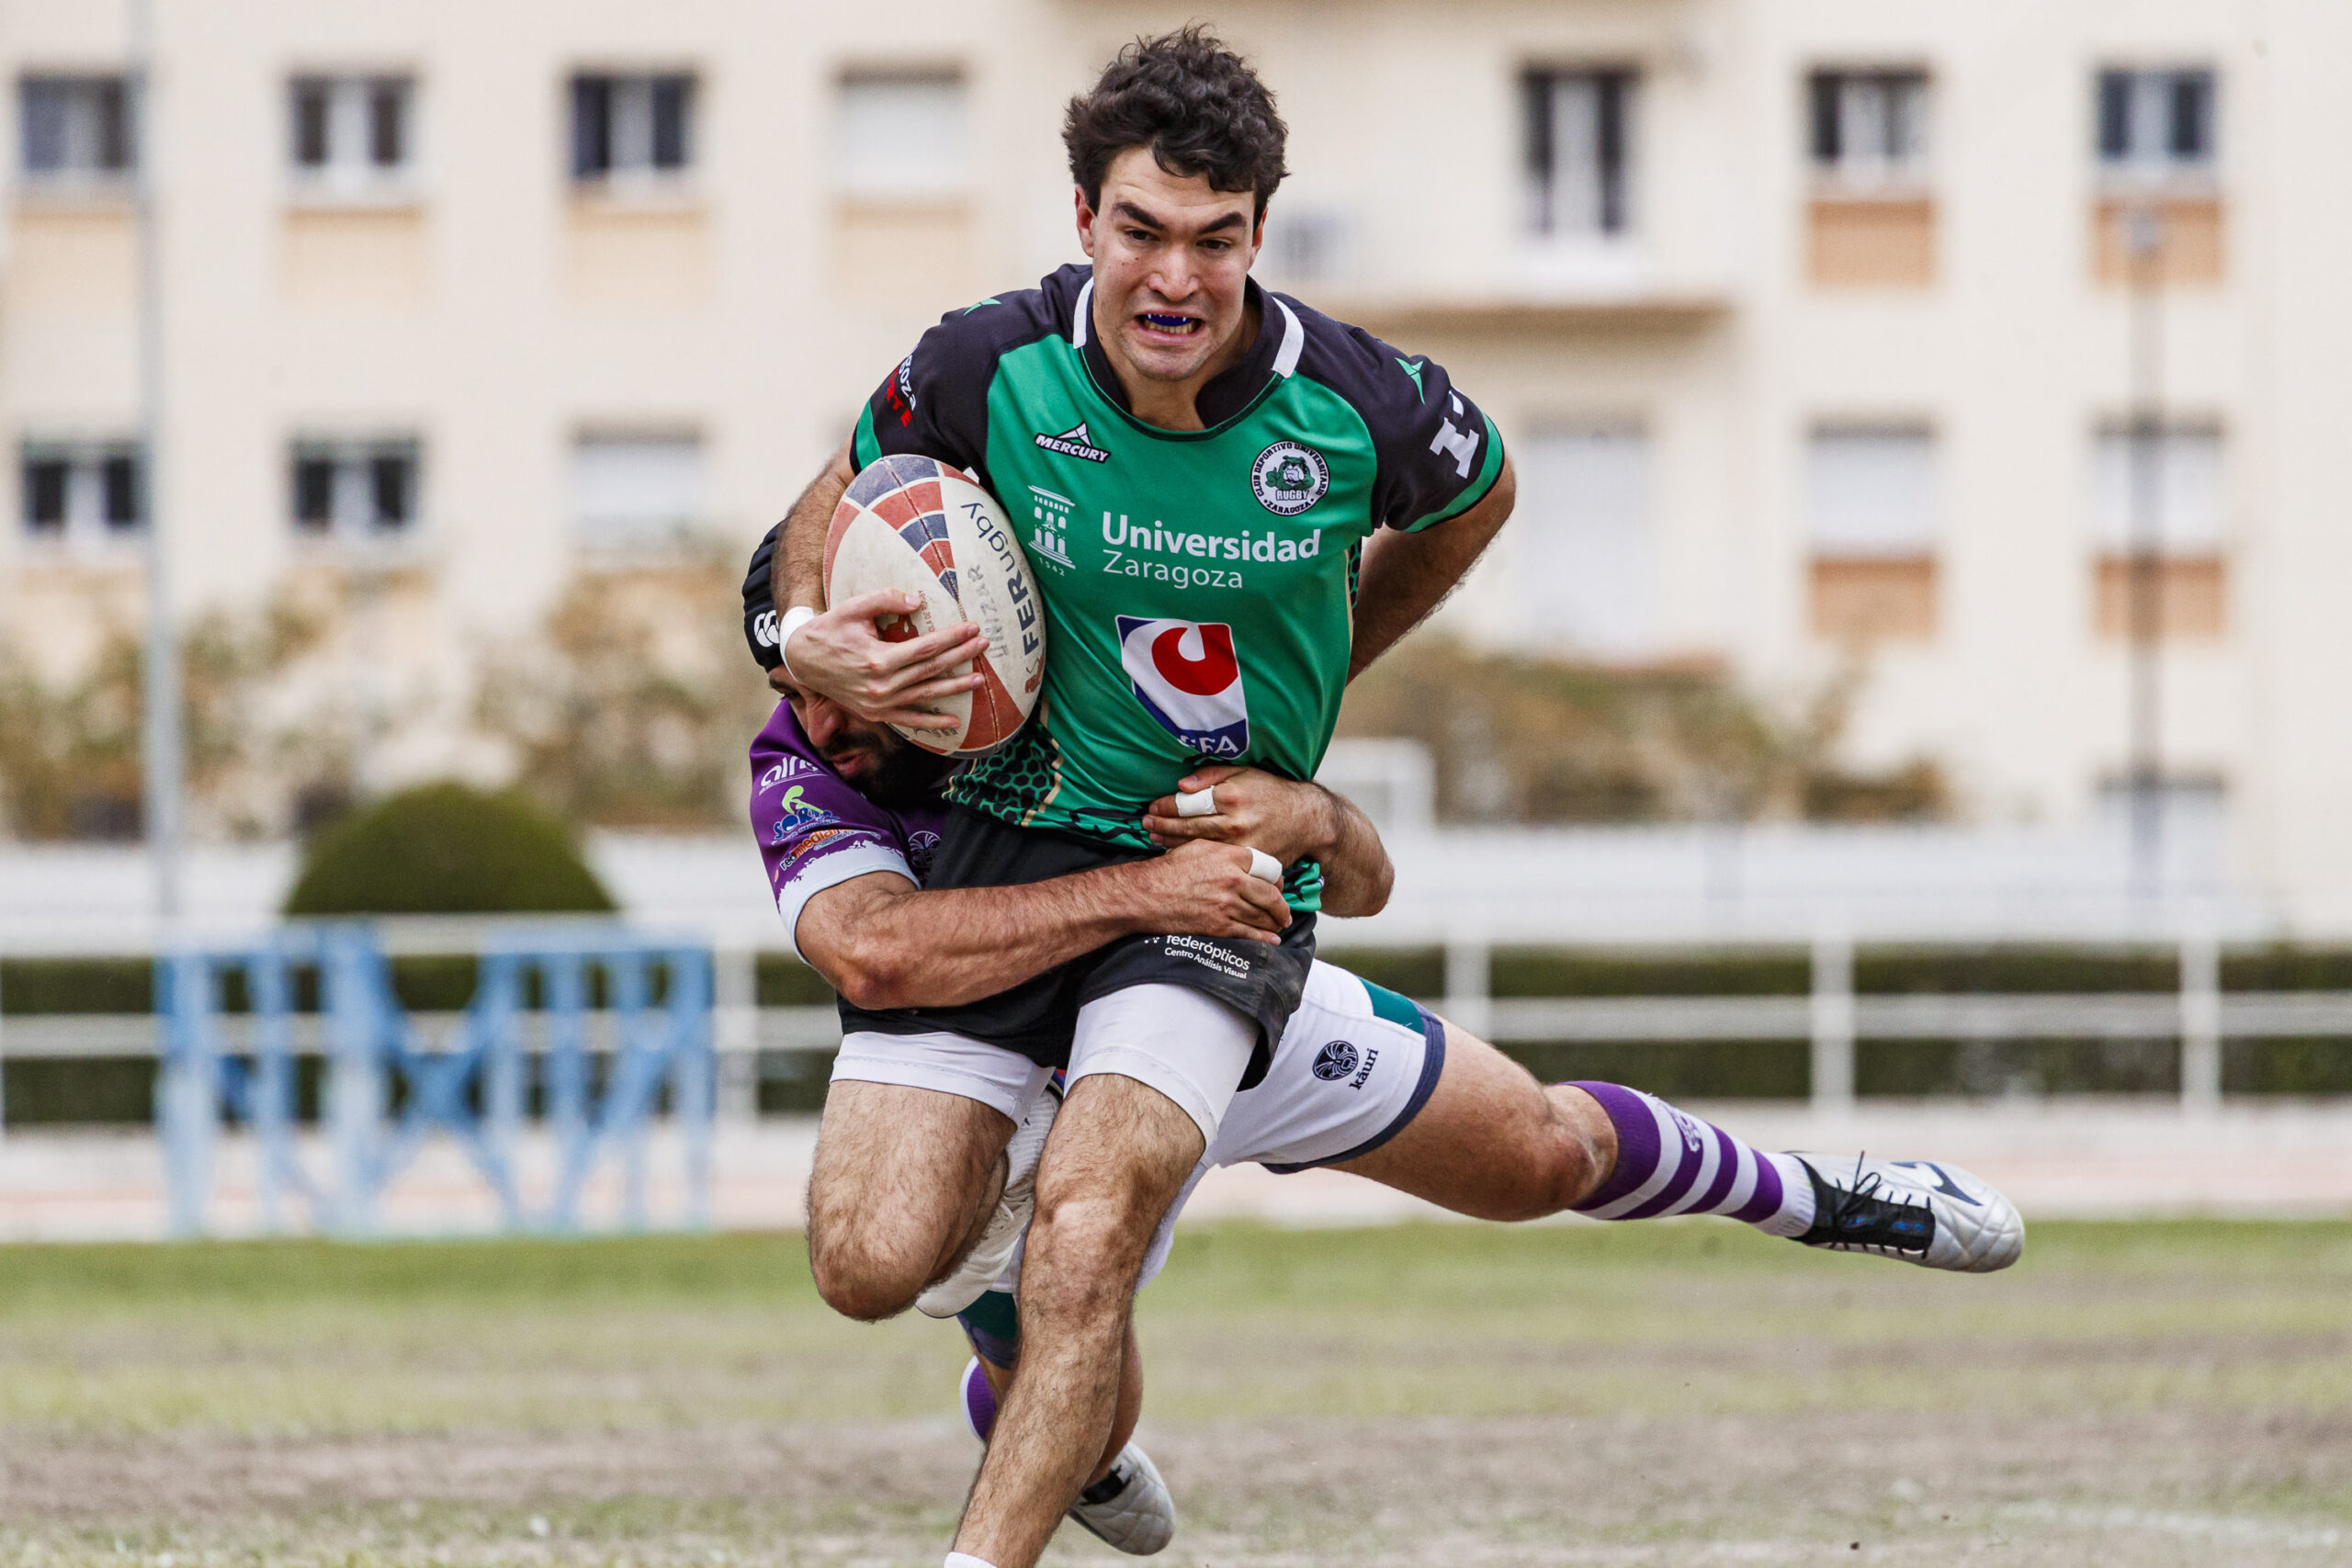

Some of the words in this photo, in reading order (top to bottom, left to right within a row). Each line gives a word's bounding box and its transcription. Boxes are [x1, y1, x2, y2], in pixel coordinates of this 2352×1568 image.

[1035, 434, 1110, 462] MERCURY
[1254, 442, 1293, 474] DEPORTIVO
[1252, 474, 1264, 497] CLUB
[1275, 489, 1310, 501] RUGBY
[1266, 501, 1311, 514] ZARAGOZA
[1102, 511, 1321, 562] Universidad
[1102, 549, 1242, 589] Zaragoza
[1164, 947, 1194, 959] Centro
[1193, 953, 1223, 972] Análisis
[1223, 965, 1248, 979] Visual
